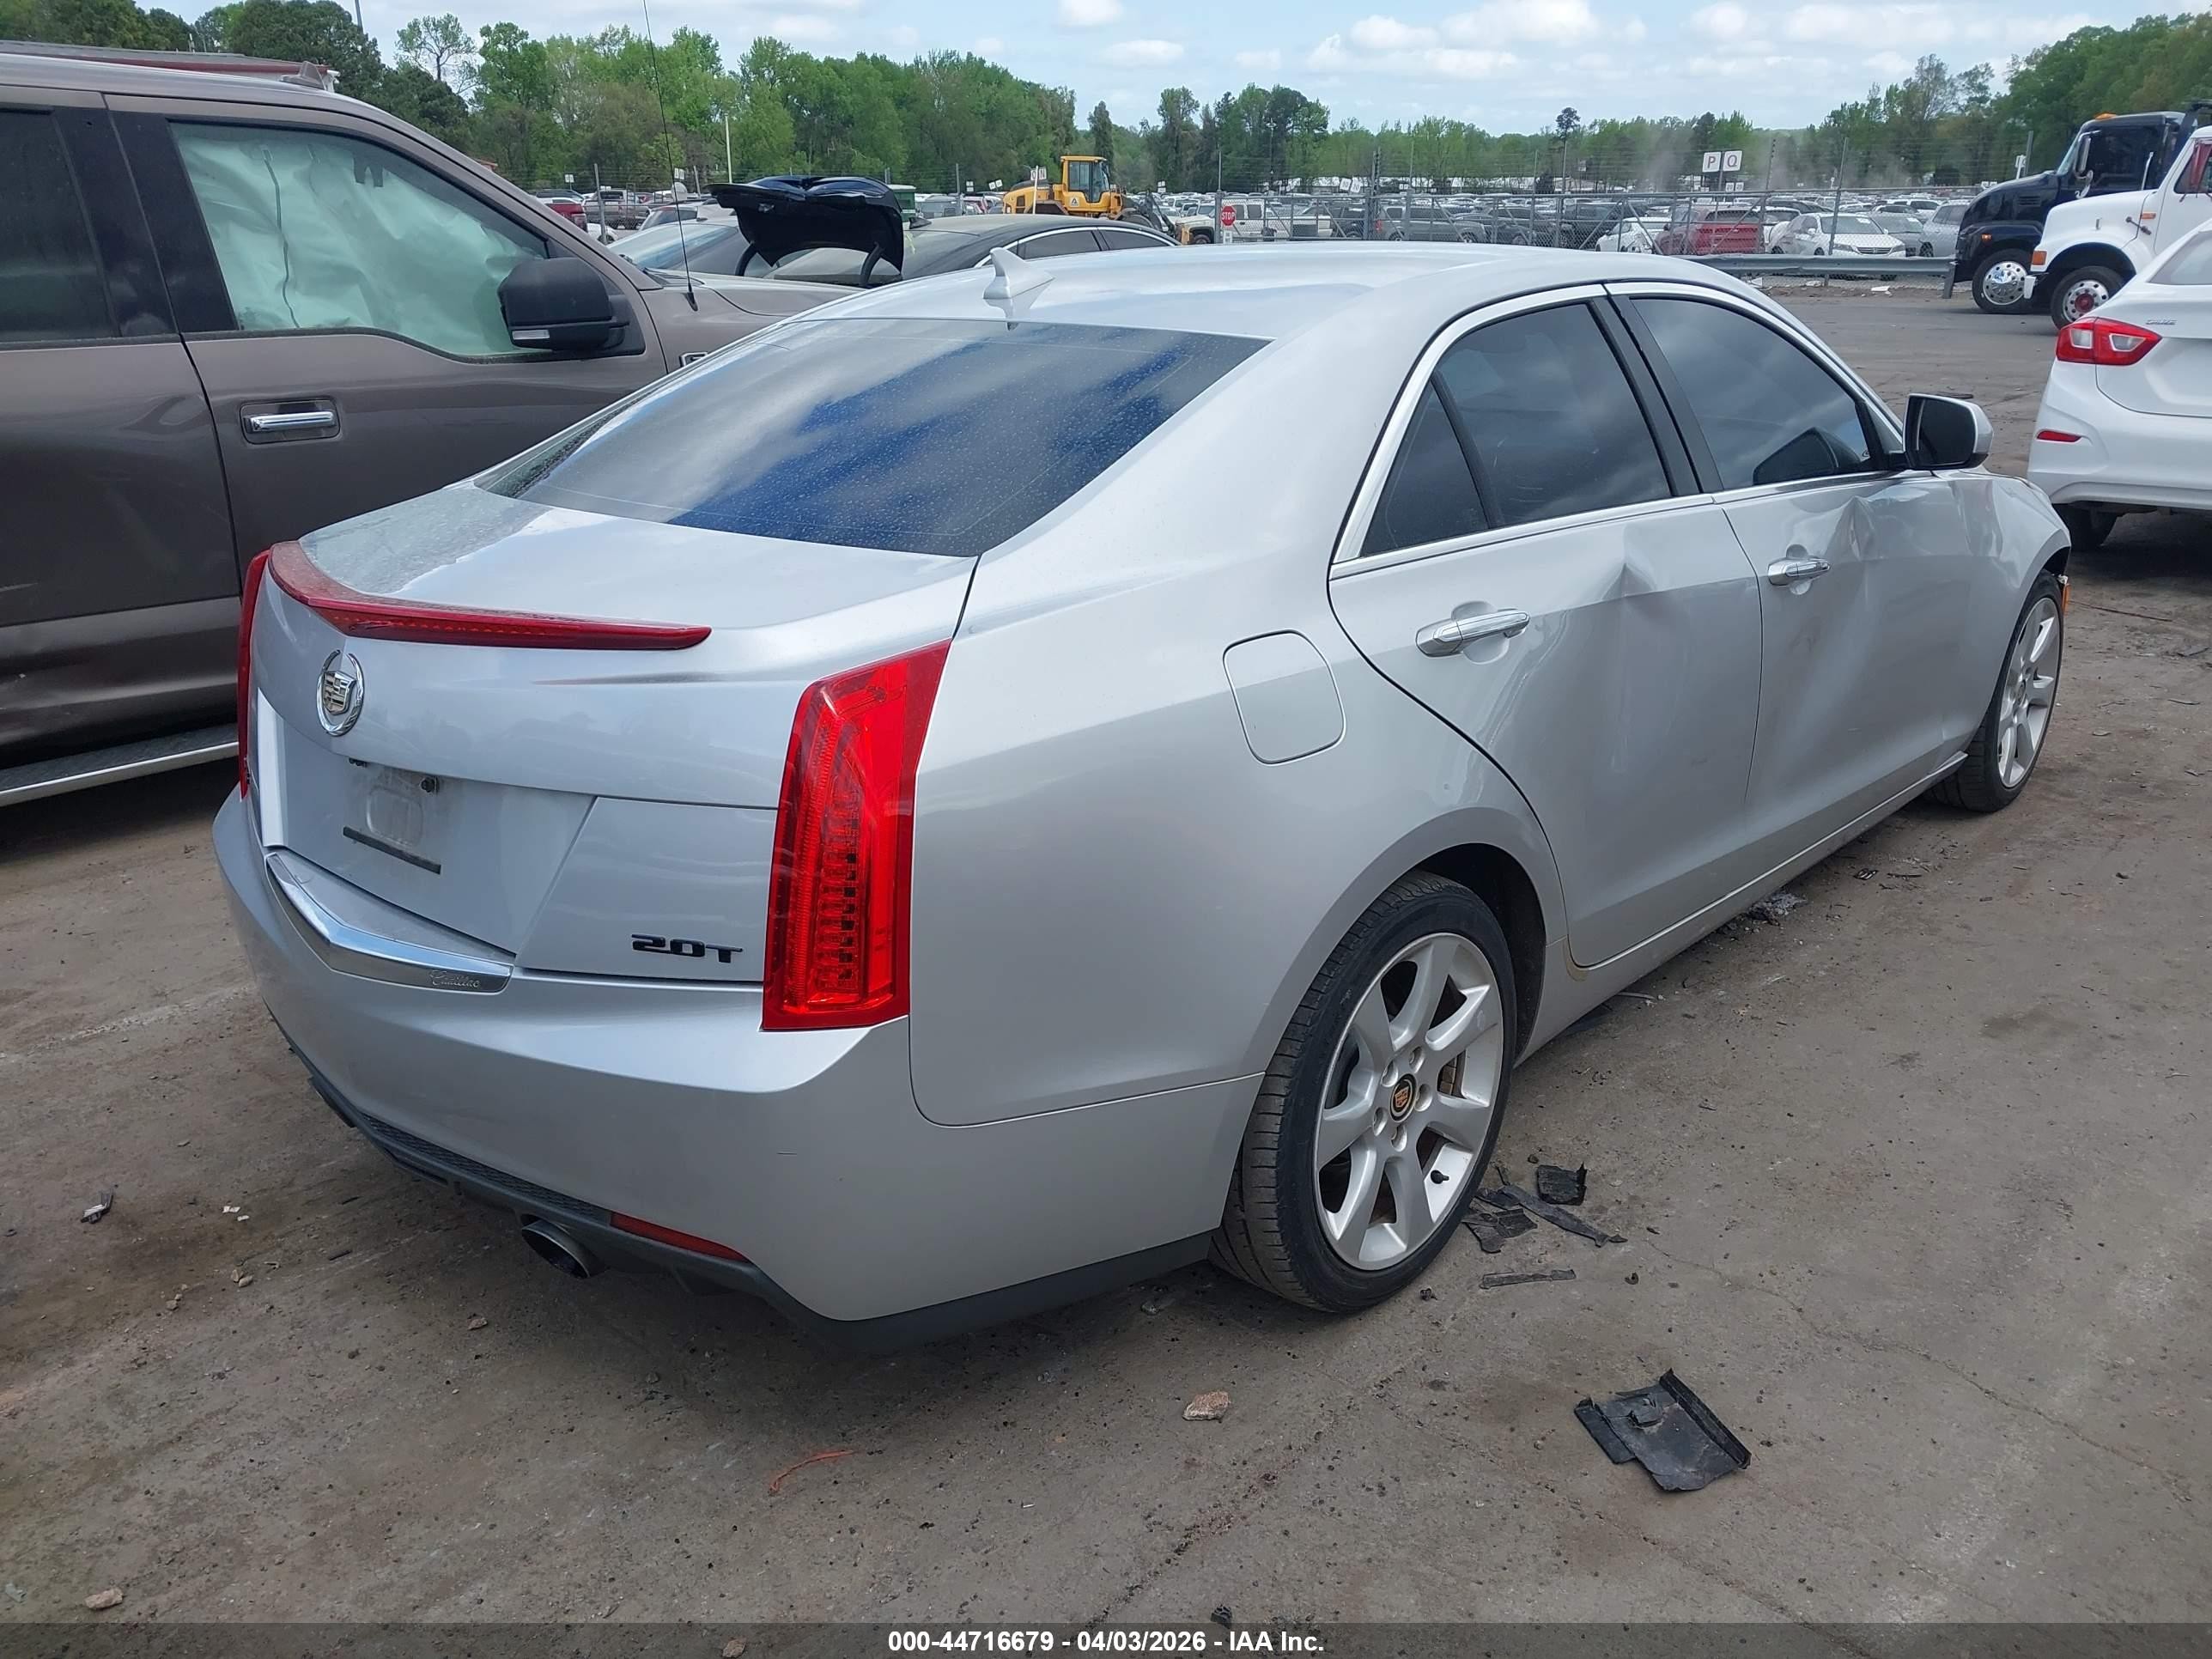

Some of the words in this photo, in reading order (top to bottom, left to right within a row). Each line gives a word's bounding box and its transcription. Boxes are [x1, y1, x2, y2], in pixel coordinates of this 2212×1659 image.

[1707, 155, 1717, 168] P
[1727, 155, 1738, 167] Q
[1221, 211, 1236, 221] STOP
